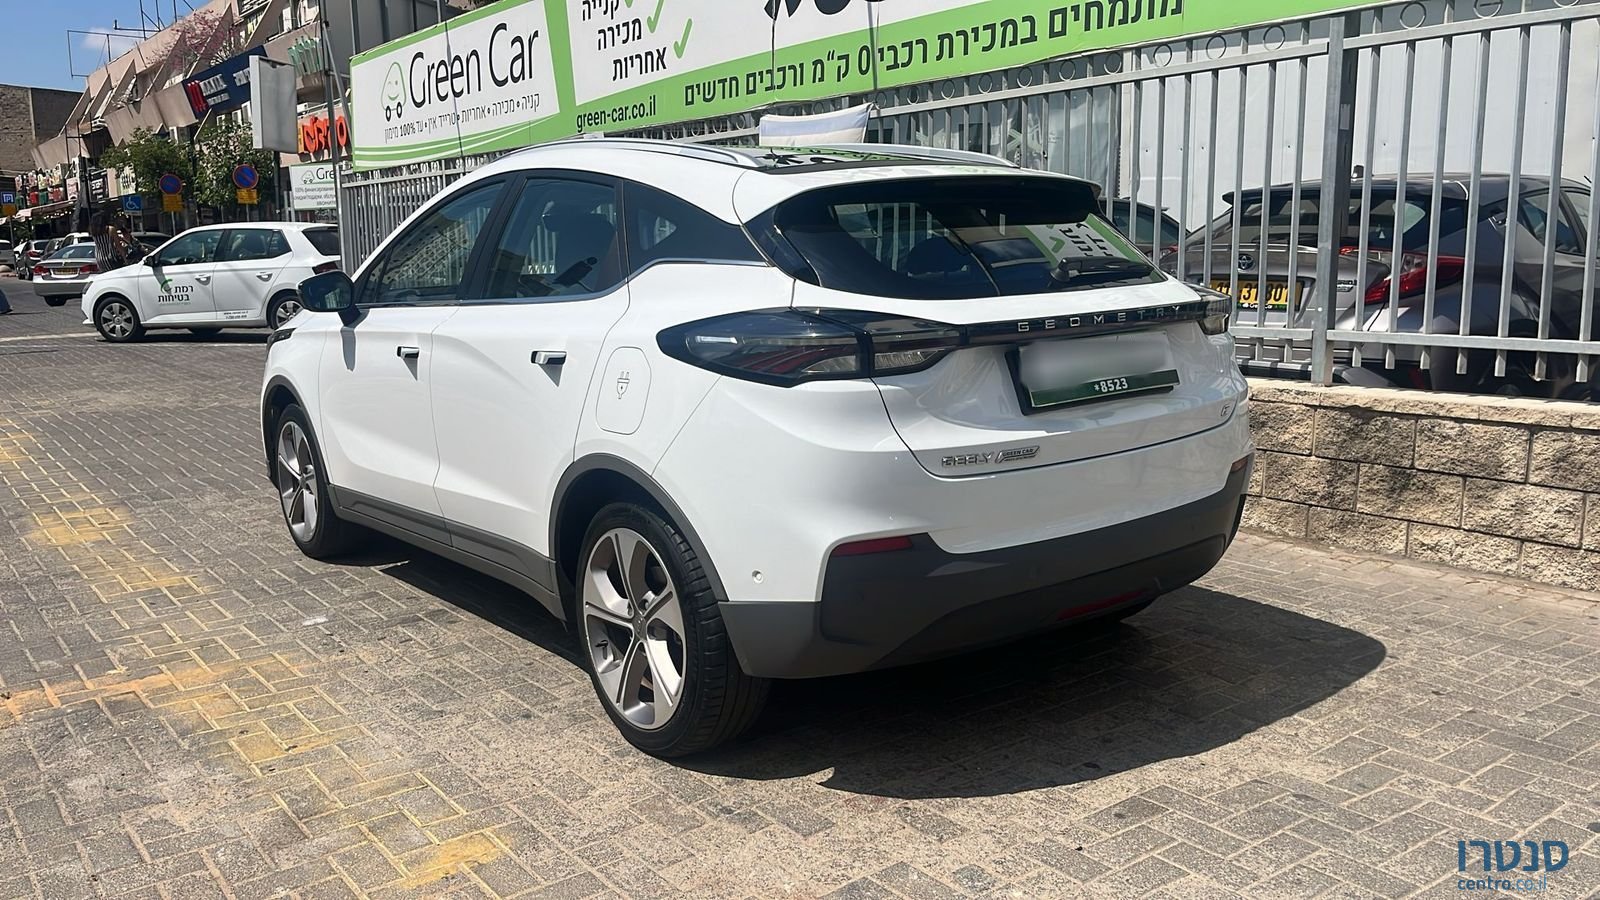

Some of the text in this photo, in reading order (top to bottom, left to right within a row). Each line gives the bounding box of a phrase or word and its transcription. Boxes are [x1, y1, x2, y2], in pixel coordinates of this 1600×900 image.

[582, 0, 620, 21] קנייה
[598, 18, 642, 51] מכירה
[935, 14, 1038, 62] במכירת
[409, 22, 539, 109] Green Car
[612, 46, 667, 81] אחריות
[858, 44, 871, 76] 0
[878, 37, 928, 71] רכבי
[685, 75, 740, 106] חדשים
[746, 61, 805, 96] ורכבים
[461, 104, 487, 123] אחריות
[492, 98, 515, 117] מכירה
[521, 93, 540, 112] קניה
[576, 94, 656, 133] green-car.co.il
[400, 121, 416, 137] 100%
[316, 167, 335, 181] Gre
[157, 293, 190, 303] בטיחות
[174, 284, 194, 294] רמת
[1018, 305, 1180, 332] GEOMETRY
[941, 451, 995, 468] GEELY
